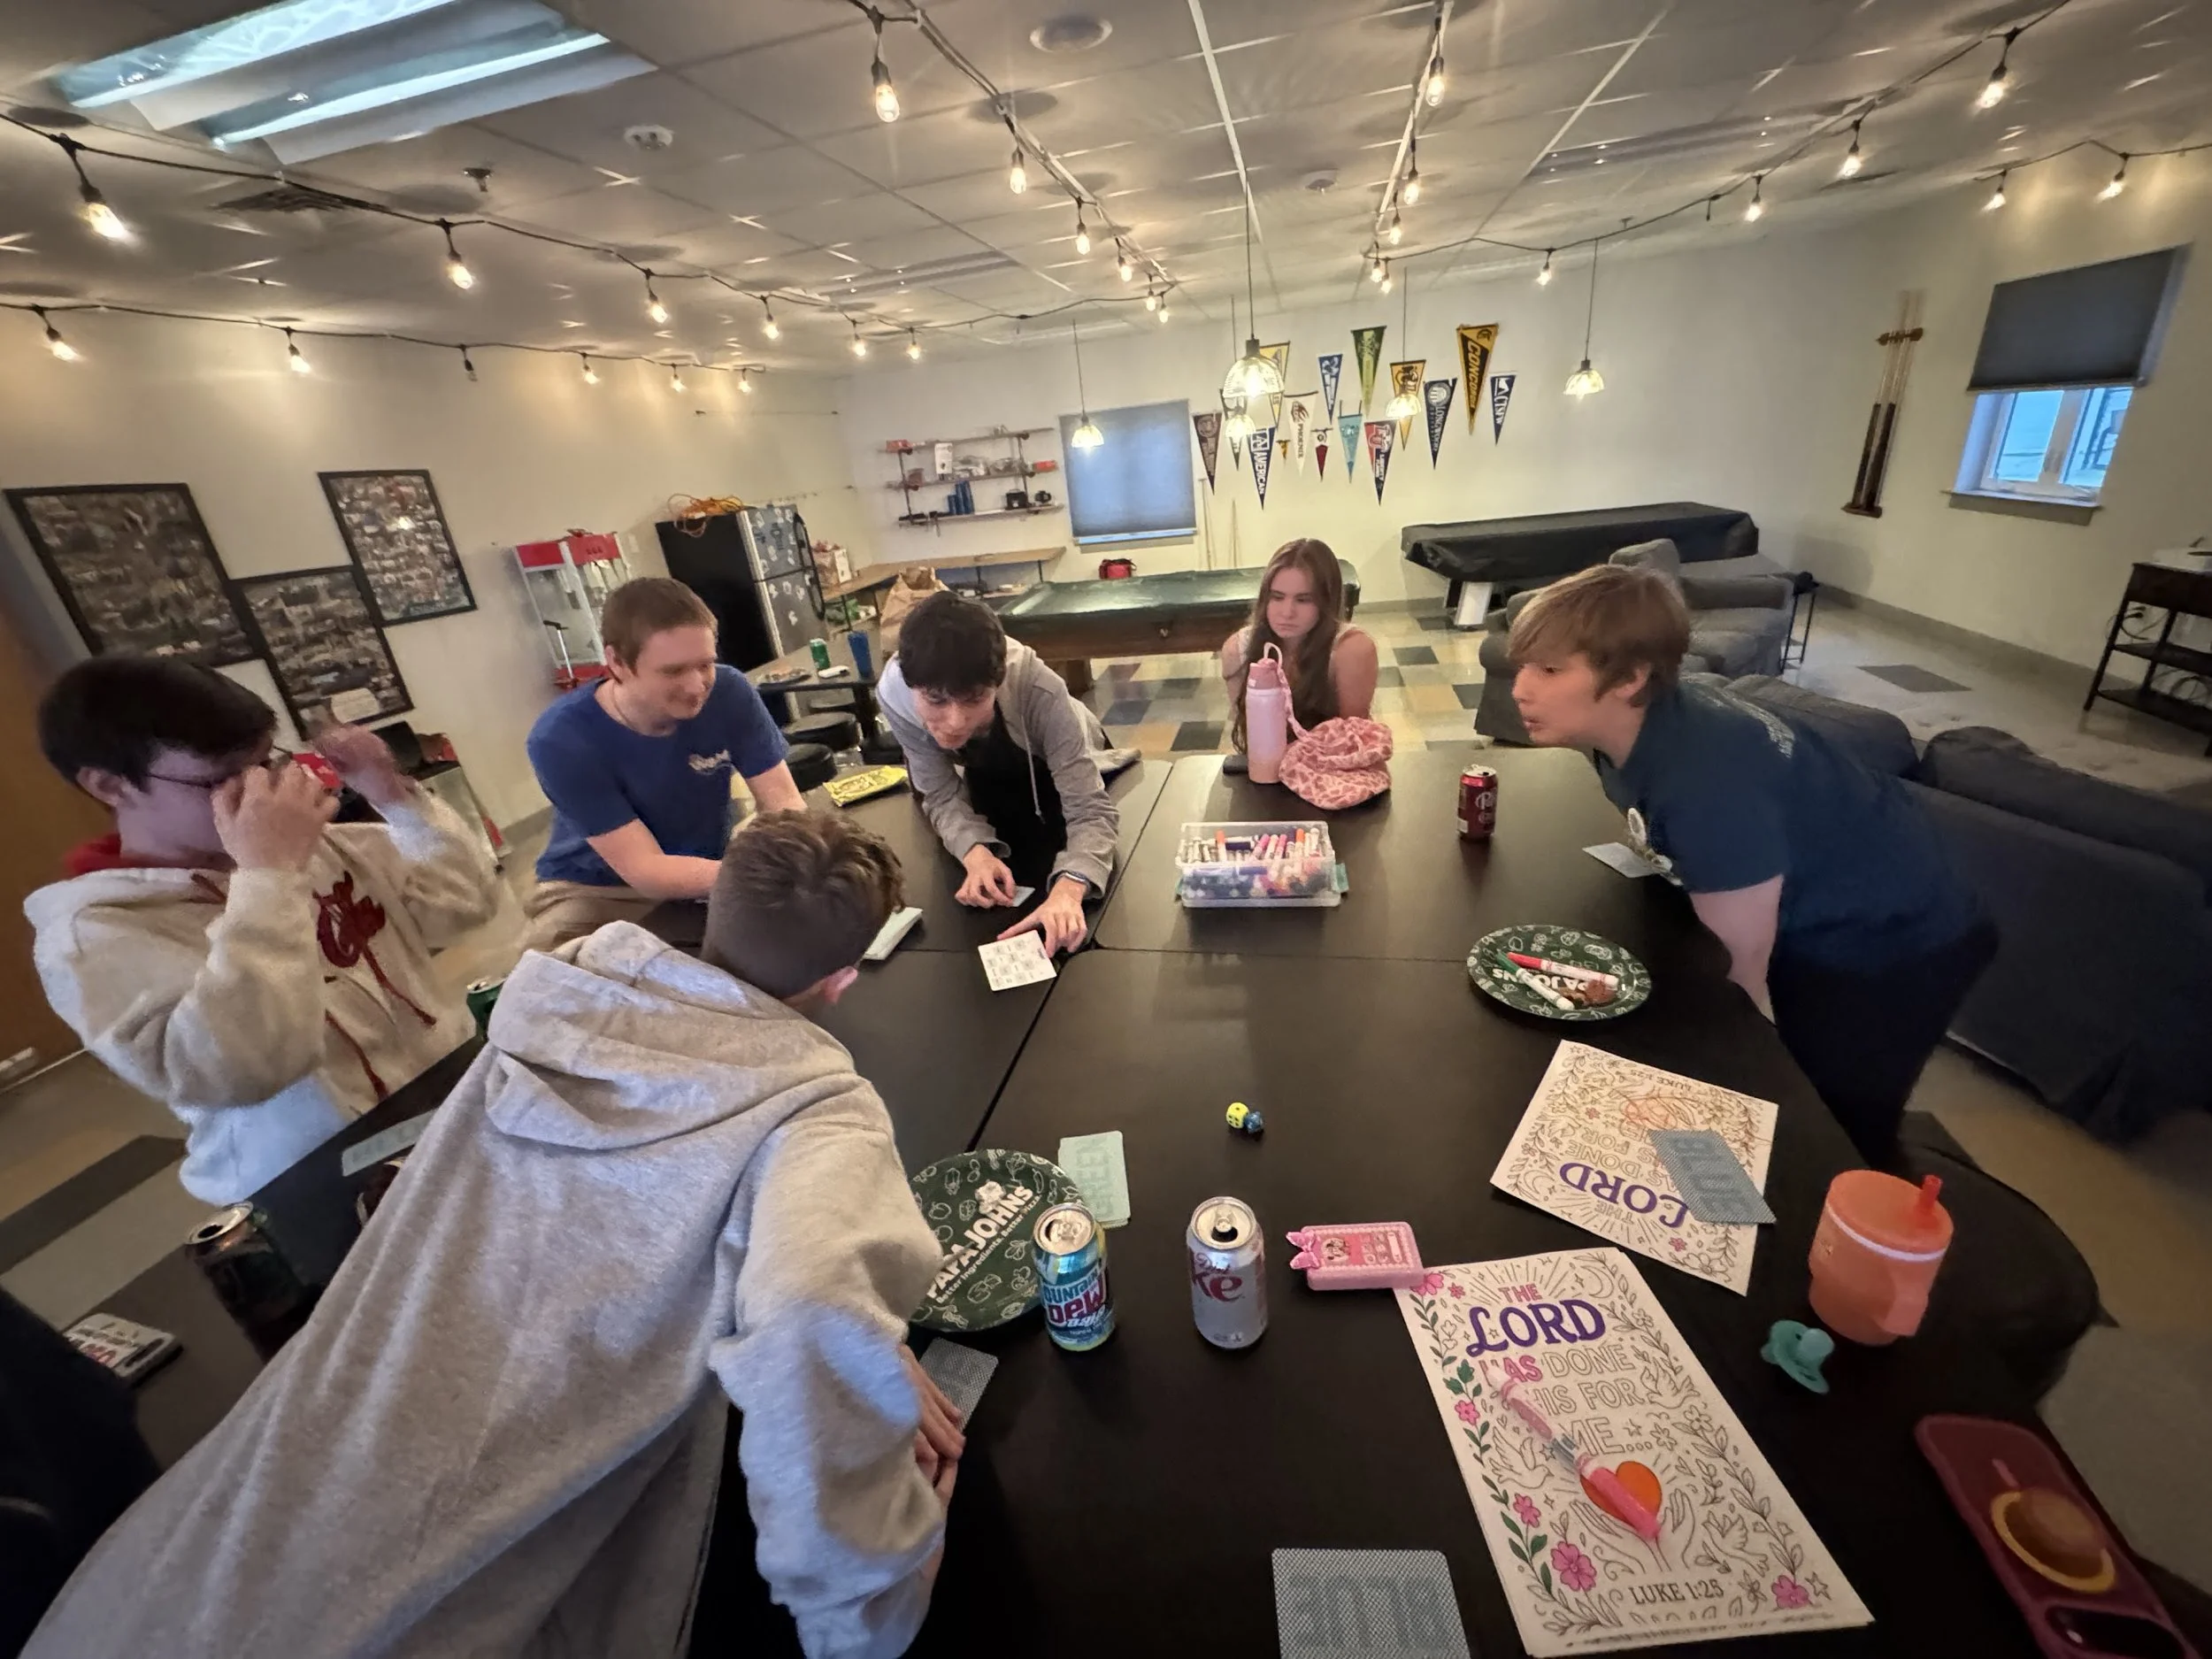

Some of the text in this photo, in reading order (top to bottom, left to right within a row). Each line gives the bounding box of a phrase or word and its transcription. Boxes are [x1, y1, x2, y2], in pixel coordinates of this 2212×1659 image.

[1253, 451, 1268, 495] AMERICAN
[1565, 1139, 1643, 1179] DONE
[1559, 1162, 1689, 1229] LORD
[1498, 1283, 1543, 1303] THE
[1465, 1299, 1606, 1357] LORD
[1542, 1343, 1636, 1379] DONE
[1577, 1378, 1646, 1410] FOR
[1628, 1578, 1724, 1605] LUKE 1:25
